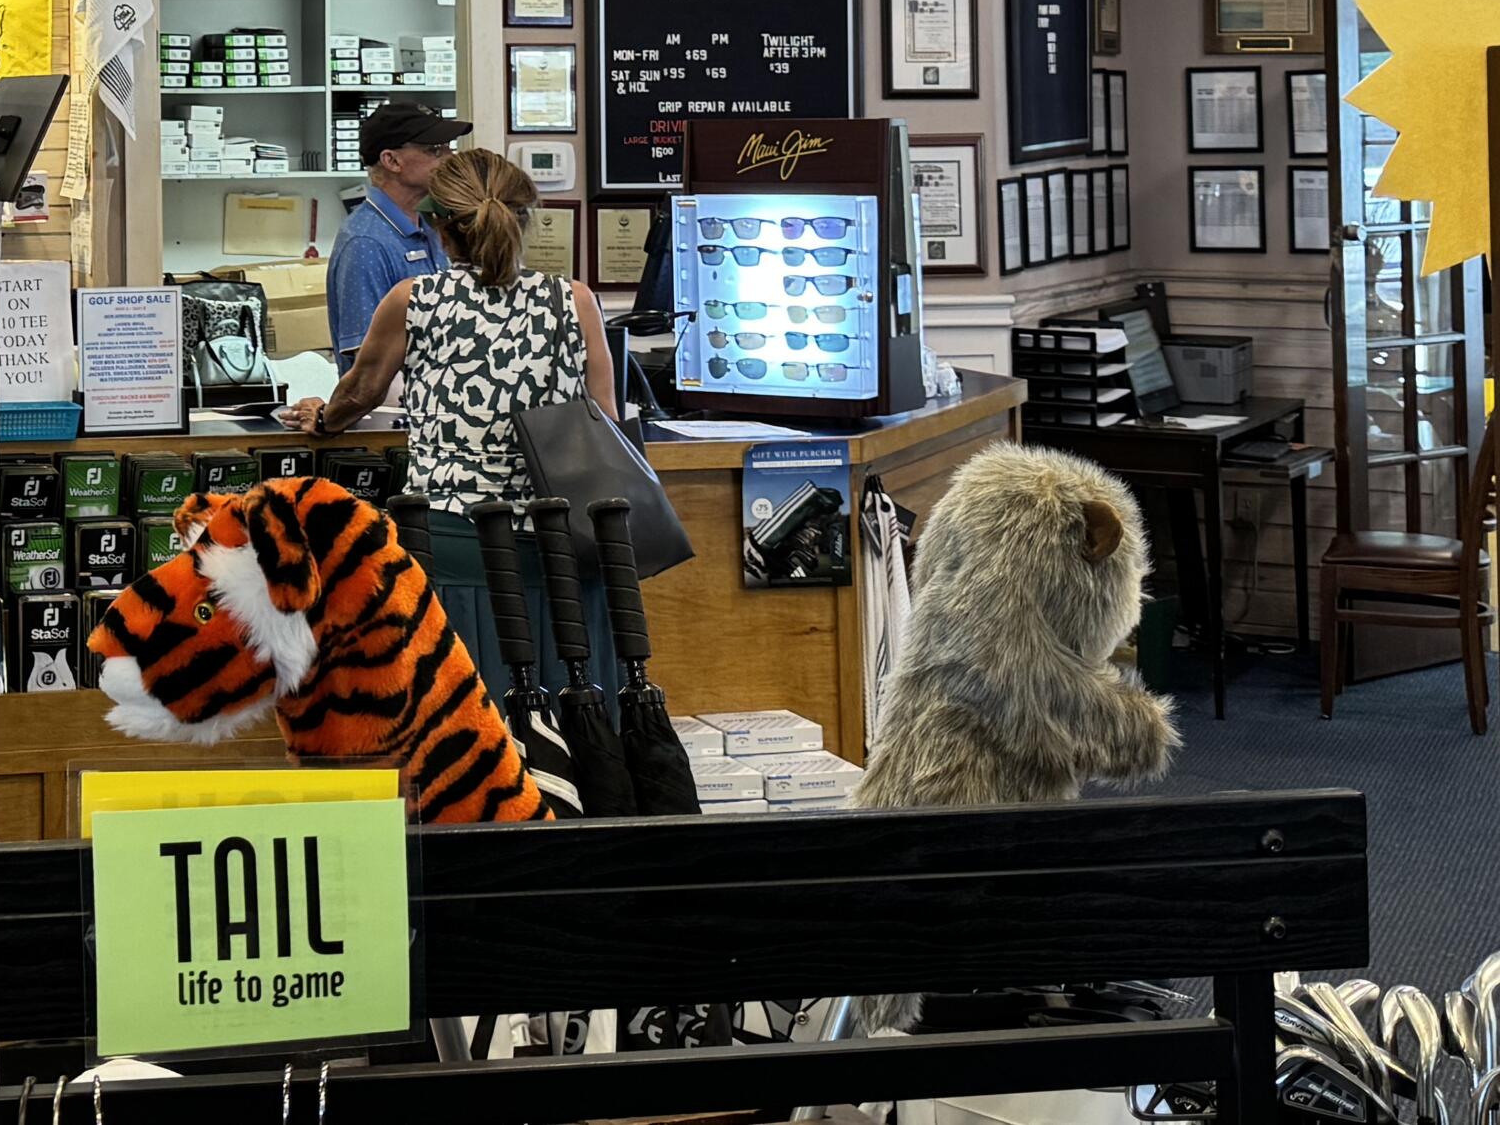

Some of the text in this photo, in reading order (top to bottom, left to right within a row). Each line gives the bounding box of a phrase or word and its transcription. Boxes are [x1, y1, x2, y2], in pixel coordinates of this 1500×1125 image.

[665, 33, 681, 45] AM
[711, 33, 729, 45] PM
[613, 49, 708, 61] MON-FRI $69
[763, 47, 799, 58] AFTER
[611, 67, 727, 81] SAT SUN $95 $69
[769, 62, 790, 74] $39
[617, 82, 649, 94] & HOL
[658, 101, 791, 112] GRIP REPAIR AVAILABLE
[624, 136, 682, 145] LARGE BUCKET
[737, 129, 834, 180] Maui Jim
[7, 297, 30, 311] ON
[89, 295, 171, 305] GOLF SHOP SALE
[19, 315, 48, 329] TEE
[5, 371, 43, 385] YOU!
[752, 449, 842, 459] GIFT WITH PURCHASE
[86, 468, 102, 485] FJ
[24, 480, 40, 496] FJ
[161, 476, 177, 492] FJ
[69, 487, 116, 497] WeatherSof
[11, 497, 48, 507] StaSof
[11, 529, 25, 546] FJ
[100, 534, 116, 552] FJ
[13, 549, 60, 561] WeatherSof
[88, 552, 126, 565] StaSof
[43, 608, 59, 626] FJ
[31, 627, 70, 640] StaSof
[159, 835, 345, 963] TAIL
[178, 970, 345, 1008] life to game
